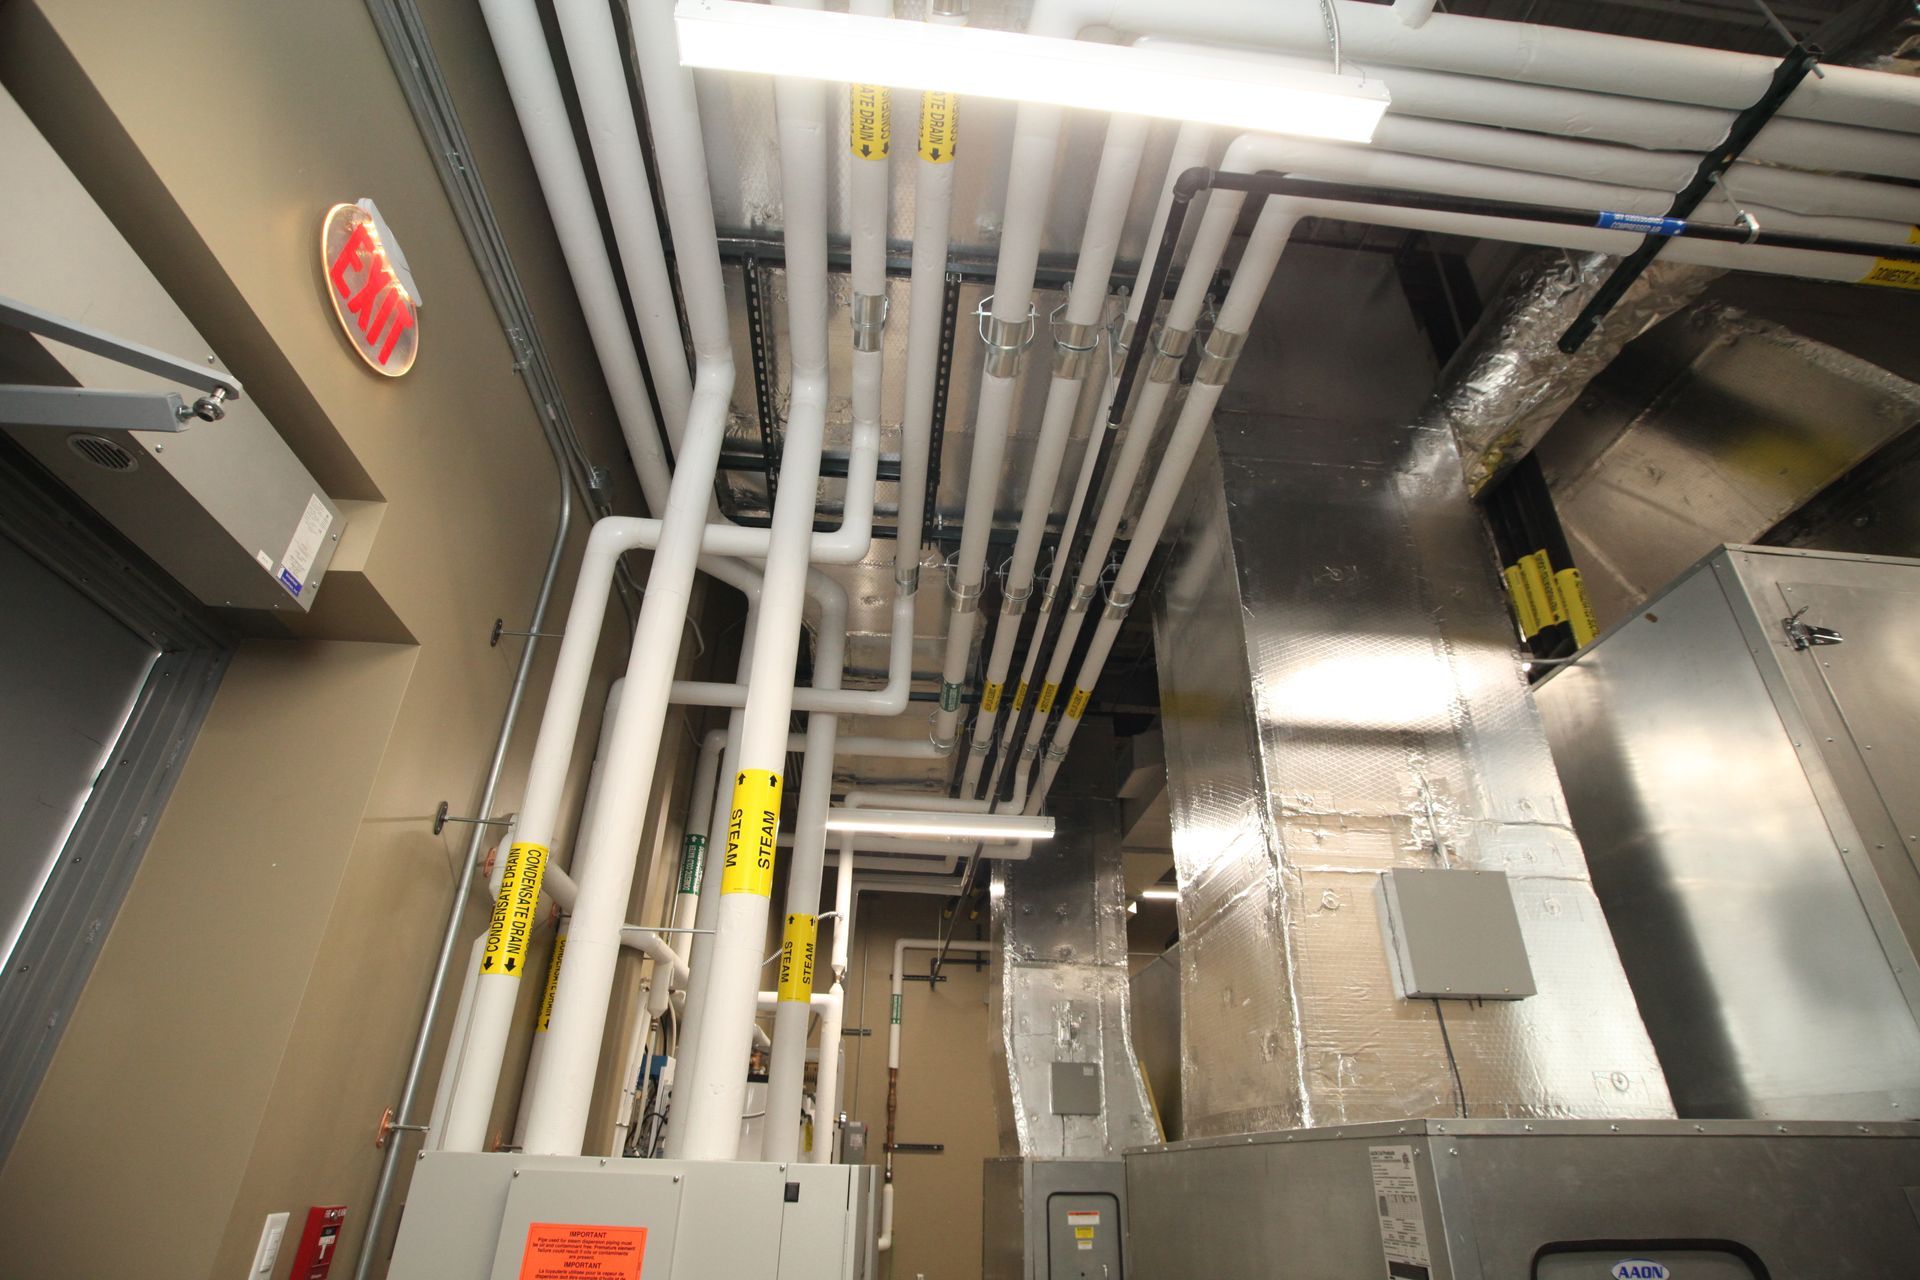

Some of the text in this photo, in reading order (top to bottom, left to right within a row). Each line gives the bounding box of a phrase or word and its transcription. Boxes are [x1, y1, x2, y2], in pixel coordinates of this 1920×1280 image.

[860, 109, 874, 142] DRAIN
[929, 113, 945, 145] DRAIN
[330, 223, 414, 366] EXIT
[726, 809, 743, 868] STEAM
[758, 810, 775, 869] STEAM
[486, 848, 521, 953] CONDENSATE DRAIN
[514, 849, 542, 919] CONDENSATE
[506, 920, 526, 955] DRAIN
[781, 941, 793, 983] STEAM
[803, 943, 813, 984] STEAM
[563, 1261, 602, 1269] IMPORTANT
[1618, 1265, 1663, 1279] AAON
